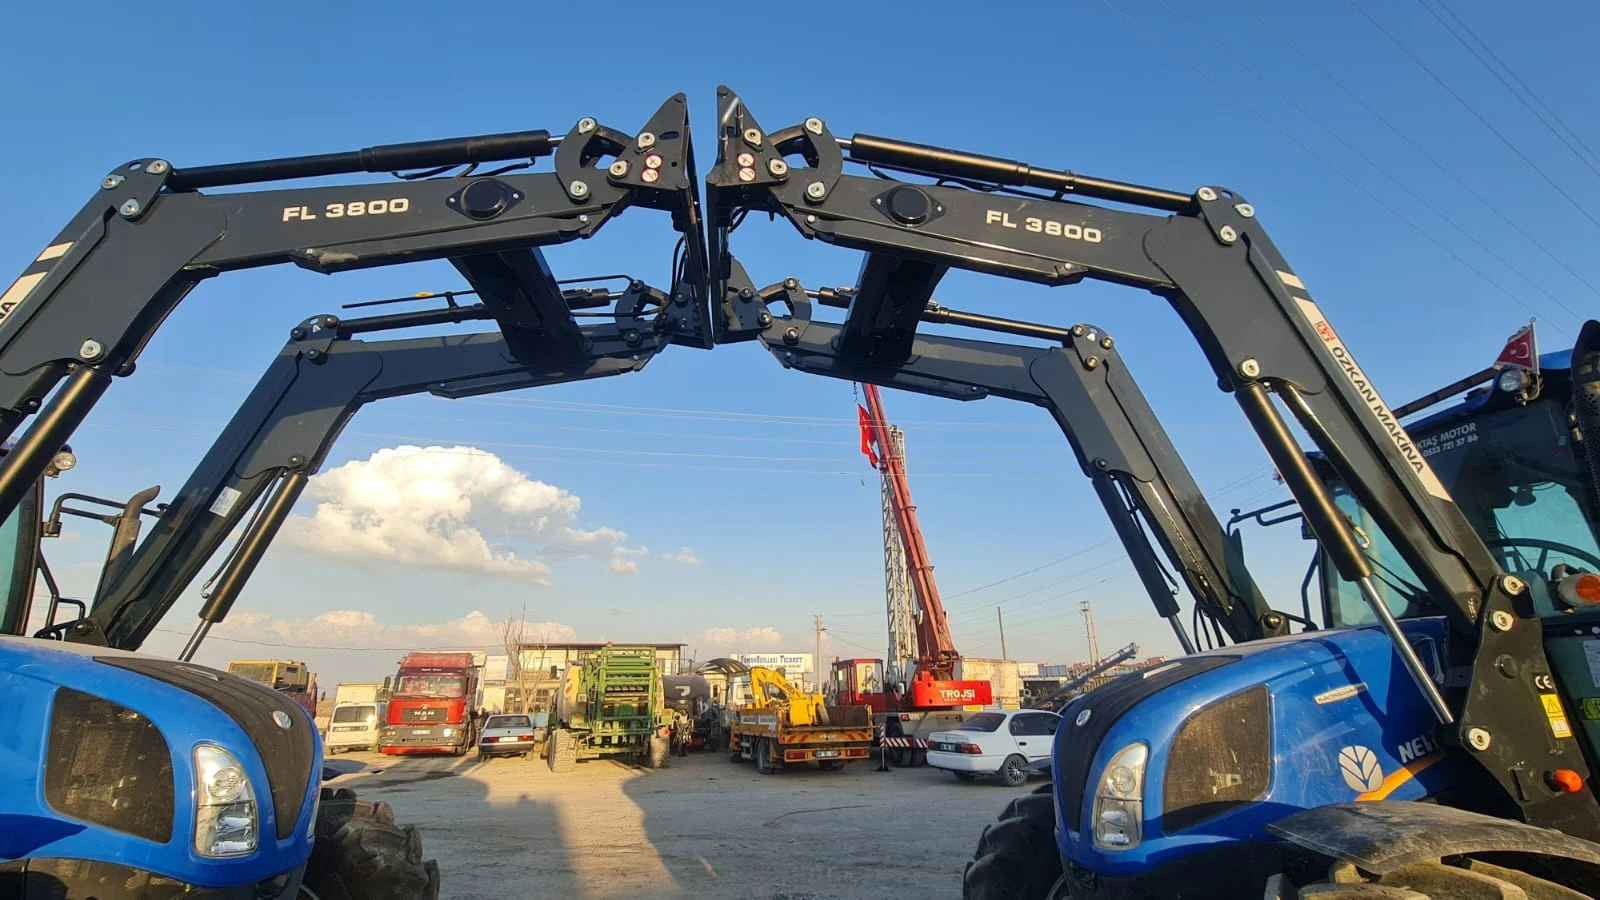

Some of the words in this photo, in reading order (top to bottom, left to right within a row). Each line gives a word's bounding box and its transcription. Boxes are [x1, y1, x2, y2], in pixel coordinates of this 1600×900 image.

[282, 206, 316, 222] FL
[325, 198, 409, 218] 3800
[986, 209, 1017, 229] FL
[1025, 217, 1102, 243] 3800
[1415, 435, 1438, 449] KTAŞ
[1440, 422, 1477, 442] MOTOR
